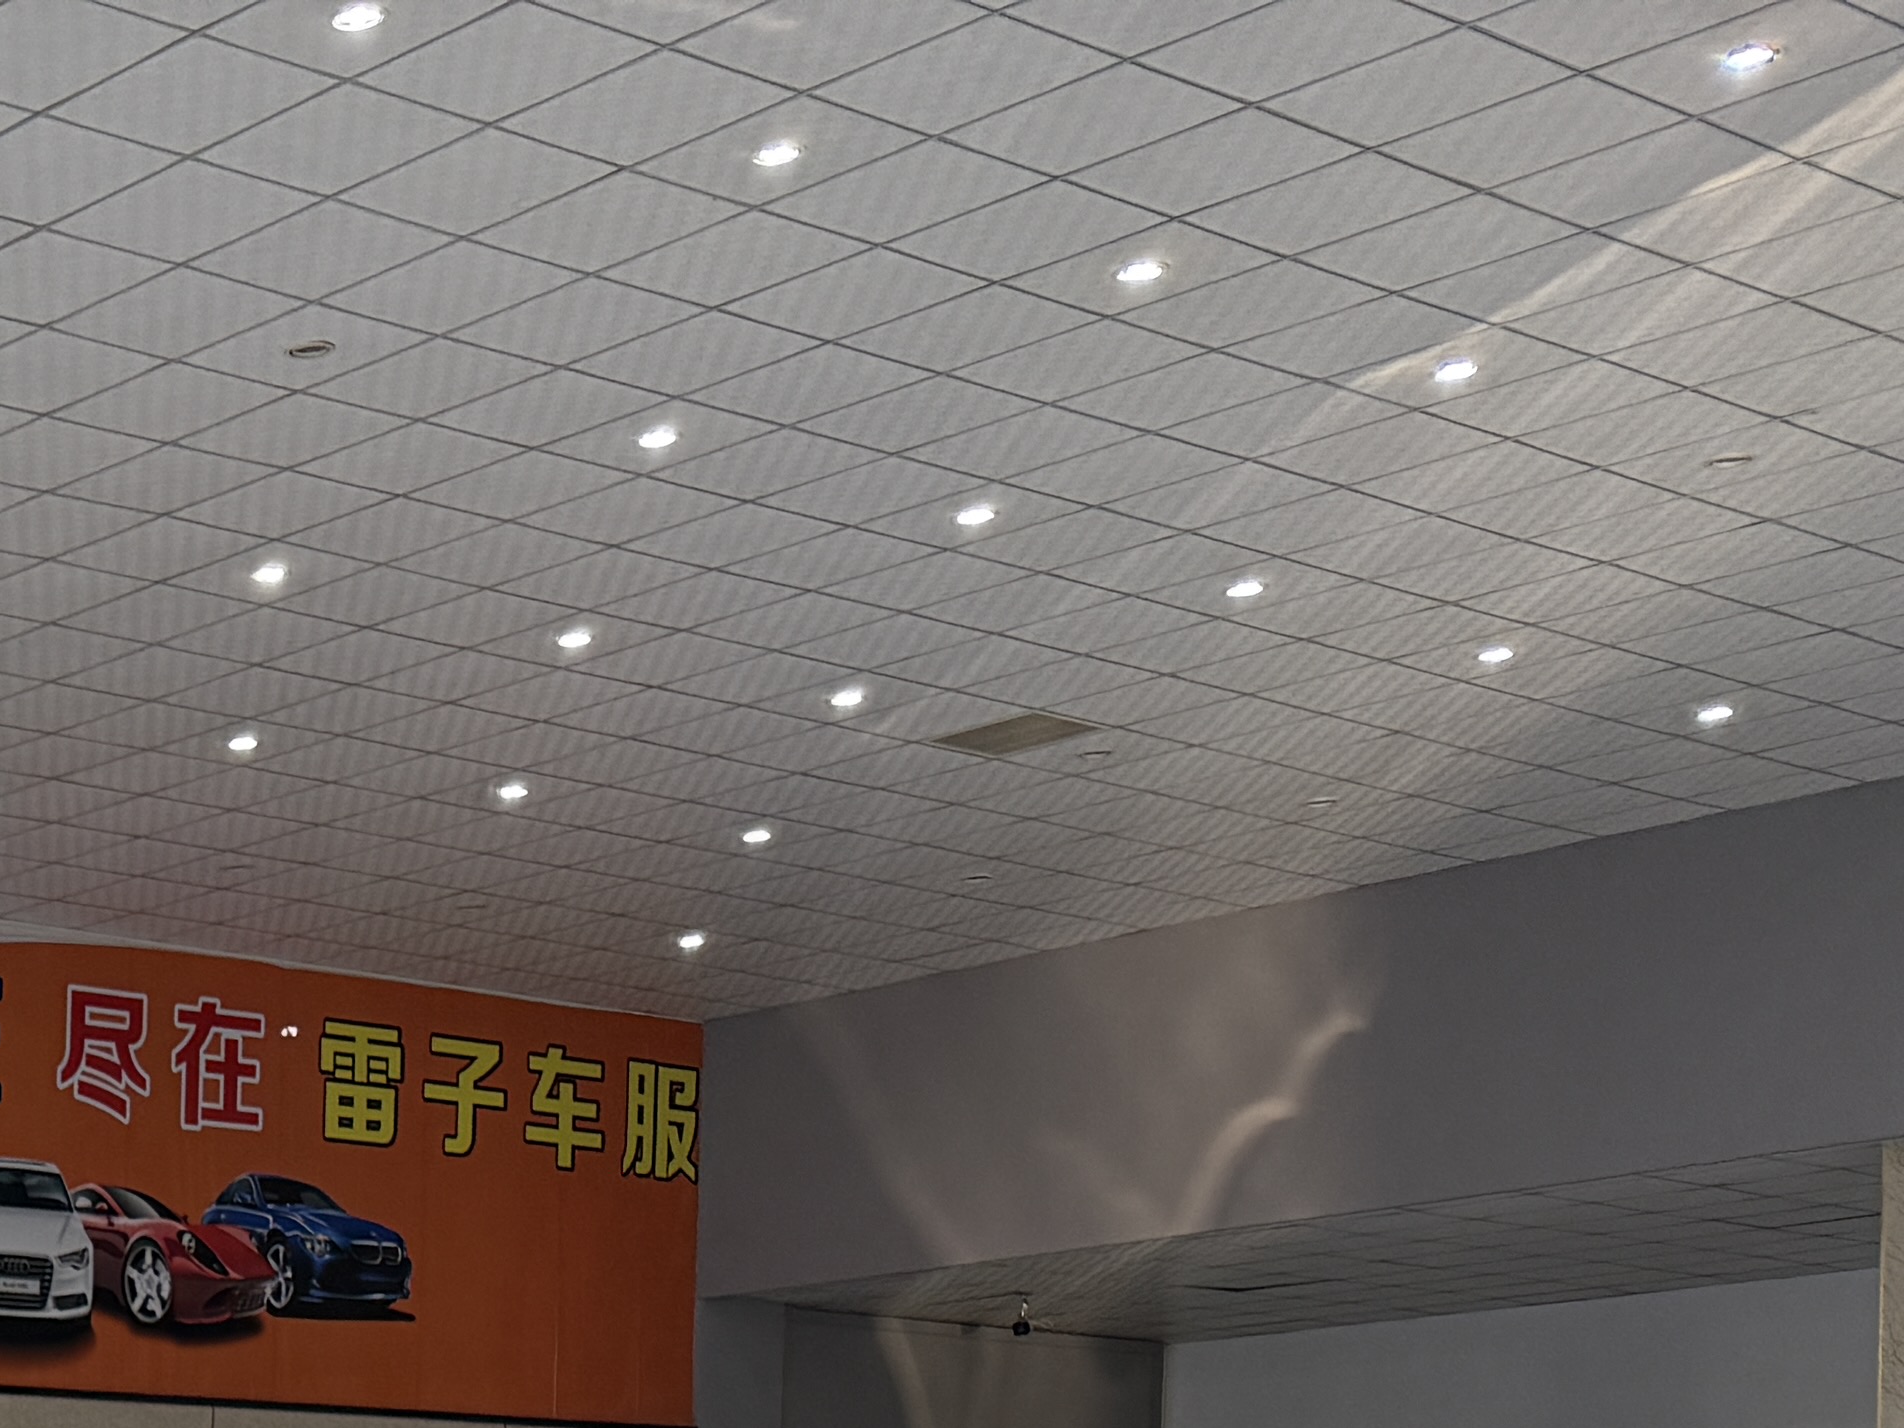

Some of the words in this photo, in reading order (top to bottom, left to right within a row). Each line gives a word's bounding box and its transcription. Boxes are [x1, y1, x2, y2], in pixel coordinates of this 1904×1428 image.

[57, 984, 267, 1133] 尽在
[318, 1017, 699, 1183] 雷子车服
